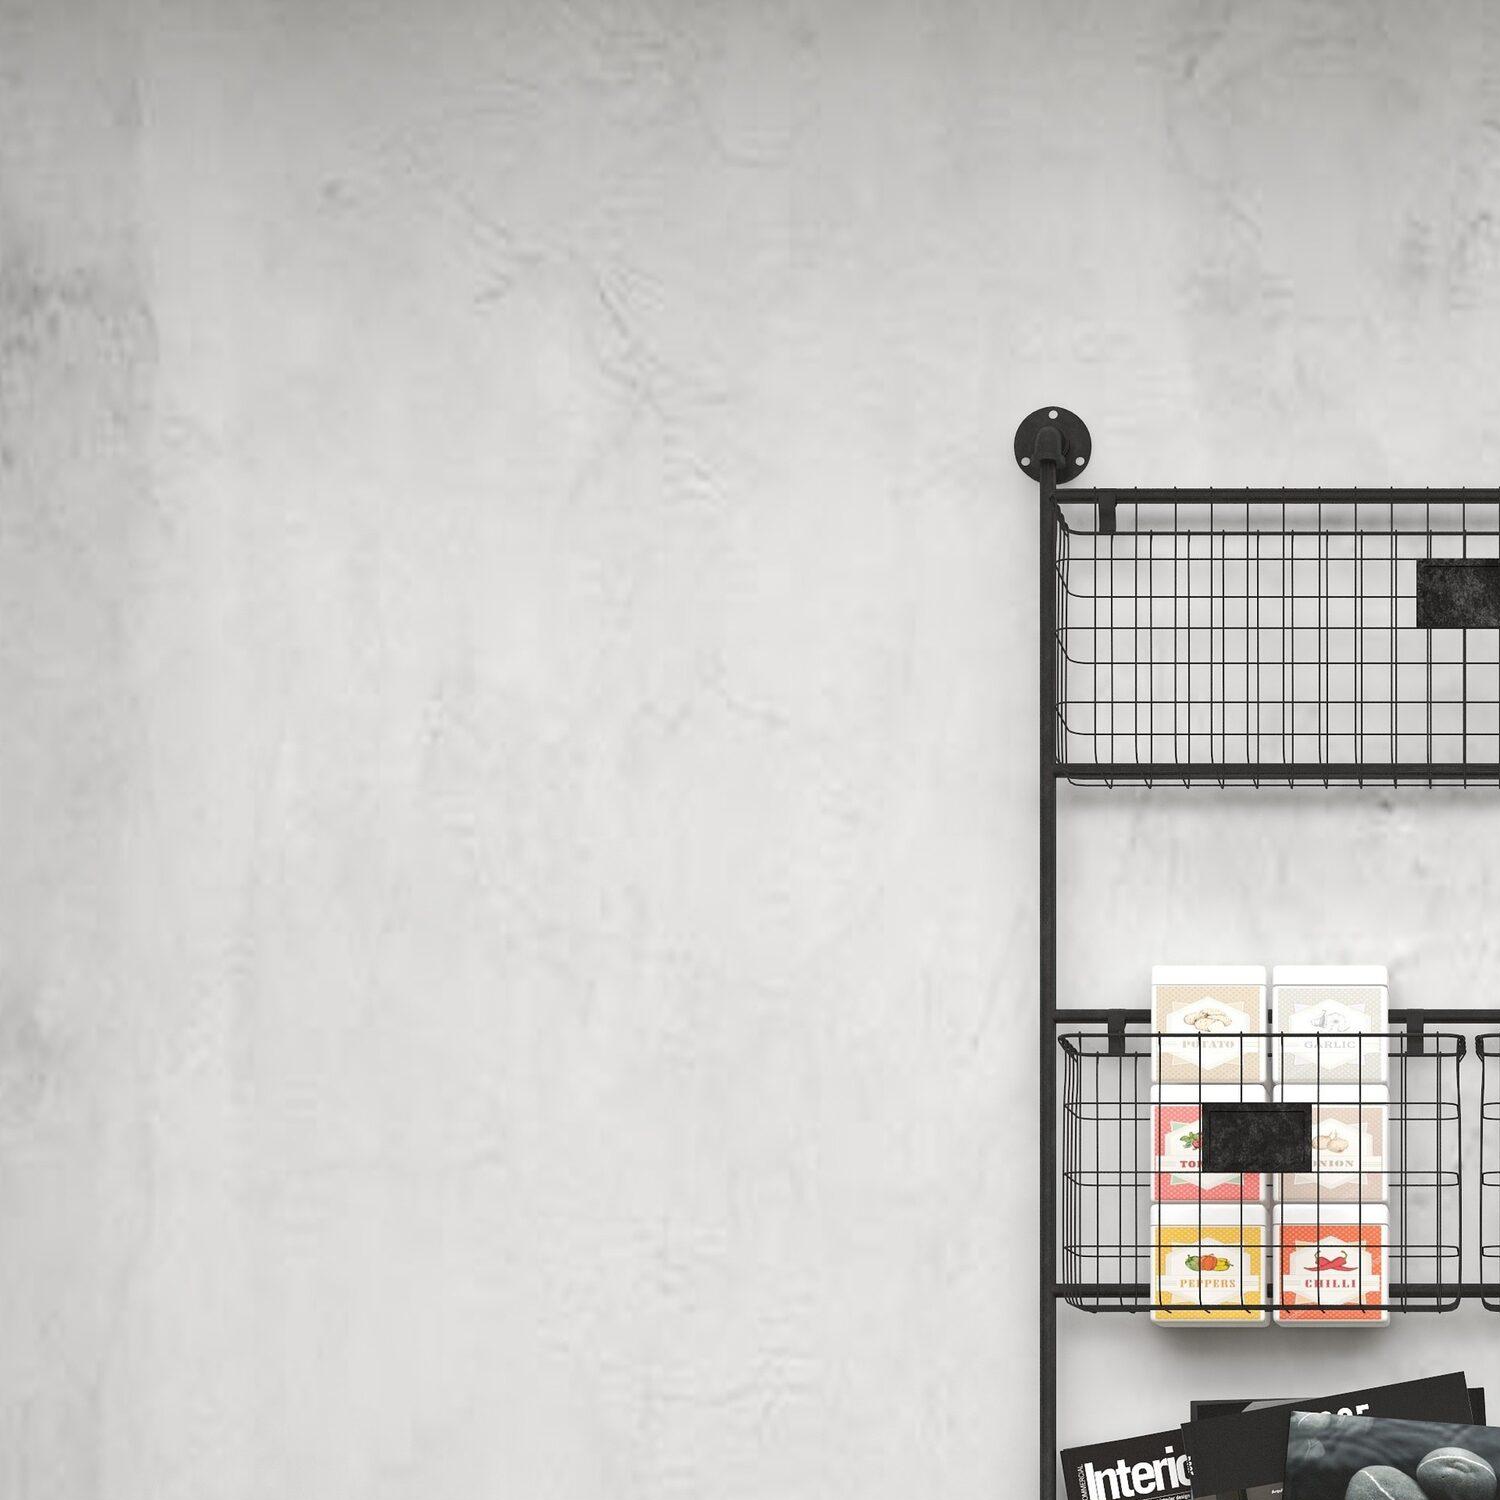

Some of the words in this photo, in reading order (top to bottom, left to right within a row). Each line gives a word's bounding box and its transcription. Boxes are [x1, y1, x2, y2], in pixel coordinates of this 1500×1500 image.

[1182, 1040, 1235, 1049] POTATO
[1304, 1040, 1356, 1049] GARLIC
[1313, 1160, 1354, 1168] NION
[1180, 1279, 1236, 1288] PEPPERS
[1304, 1279, 1356, 1288] CHILLI
